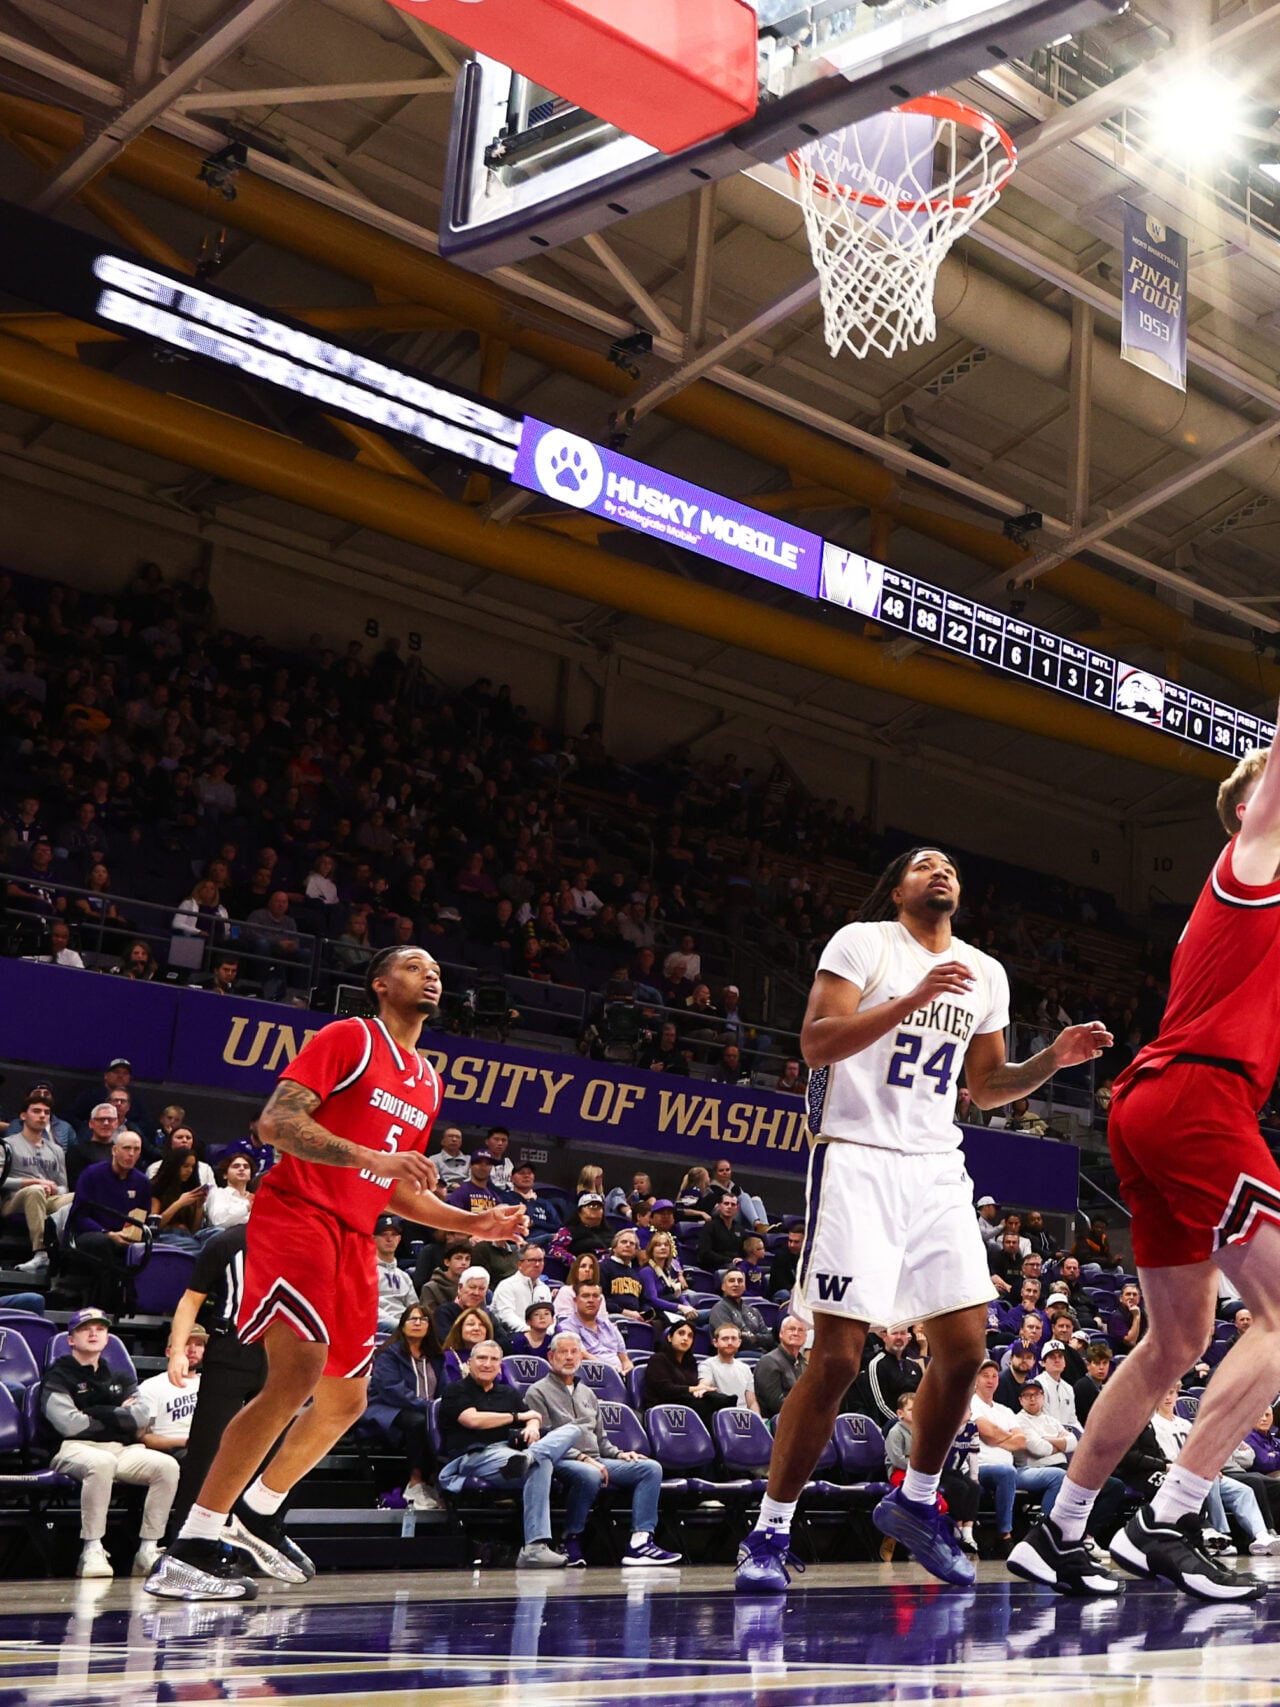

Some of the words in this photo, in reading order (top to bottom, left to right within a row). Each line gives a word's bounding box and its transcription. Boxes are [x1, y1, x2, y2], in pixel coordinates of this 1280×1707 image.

[804, 140, 913, 203] HAMPIONS
[1148, 245, 1180, 268] BASKETBALL
[1127, 255, 1182, 301] FINAL
[1129, 277, 1181, 318] FOUR
[1138, 310, 1170, 342] 1953
[606, 471, 699, 529] HUSKY
[604, 499, 617, 515] By
[617, 505, 667, 533] Collegiate
[365, 618, 378, 639] 8
[977, 610, 1002, 627] REB
[1006, 622, 1031, 638] AST
[1062, 644, 1086, 661] BLK
[1091, 655, 1112, 671] STL
[882, 596, 904, 619] 48
[916, 609, 938, 632] 88
[946, 621, 968, 645] 22
[978, 633, 997, 655] 17
[1011, 646, 1022, 665] 6
[1042, 658, 1050, 677] 1
[1067, 668, 1078, 687] 3
[1093, 679, 1105, 697] 2
[1165, 707, 1184, 728] 47
[1193, 718, 1203, 736] 0
[1214, 725, 1231, 746] 38
[1238, 733, 1253, 754] 13
[1153, 857, 1173, 872] 10
[888, 996, 974, 1042] USKIES
[886, 1031, 958, 1096] 24
[369, 1087, 429, 1131] SOUTHERN
[579, 1079, 646, 1126] OF
[657, 1089, 821, 1152] WASHIN
[381, 1124, 403, 1155] 5
[816, 1273, 853, 1302] W
[1021, 1340, 1030, 1349] W
[1050, 1342, 1060, 1350] W
[515, 1360, 539, 1378] W
[582, 1364, 605, 1382] W
[166, 1391, 197, 1412] LORE
[602, 1406, 623, 1425] W
[662, 1408, 686, 1428] W
[729, 1411, 752, 1430] W
[845, 1417, 867, 1436] W
